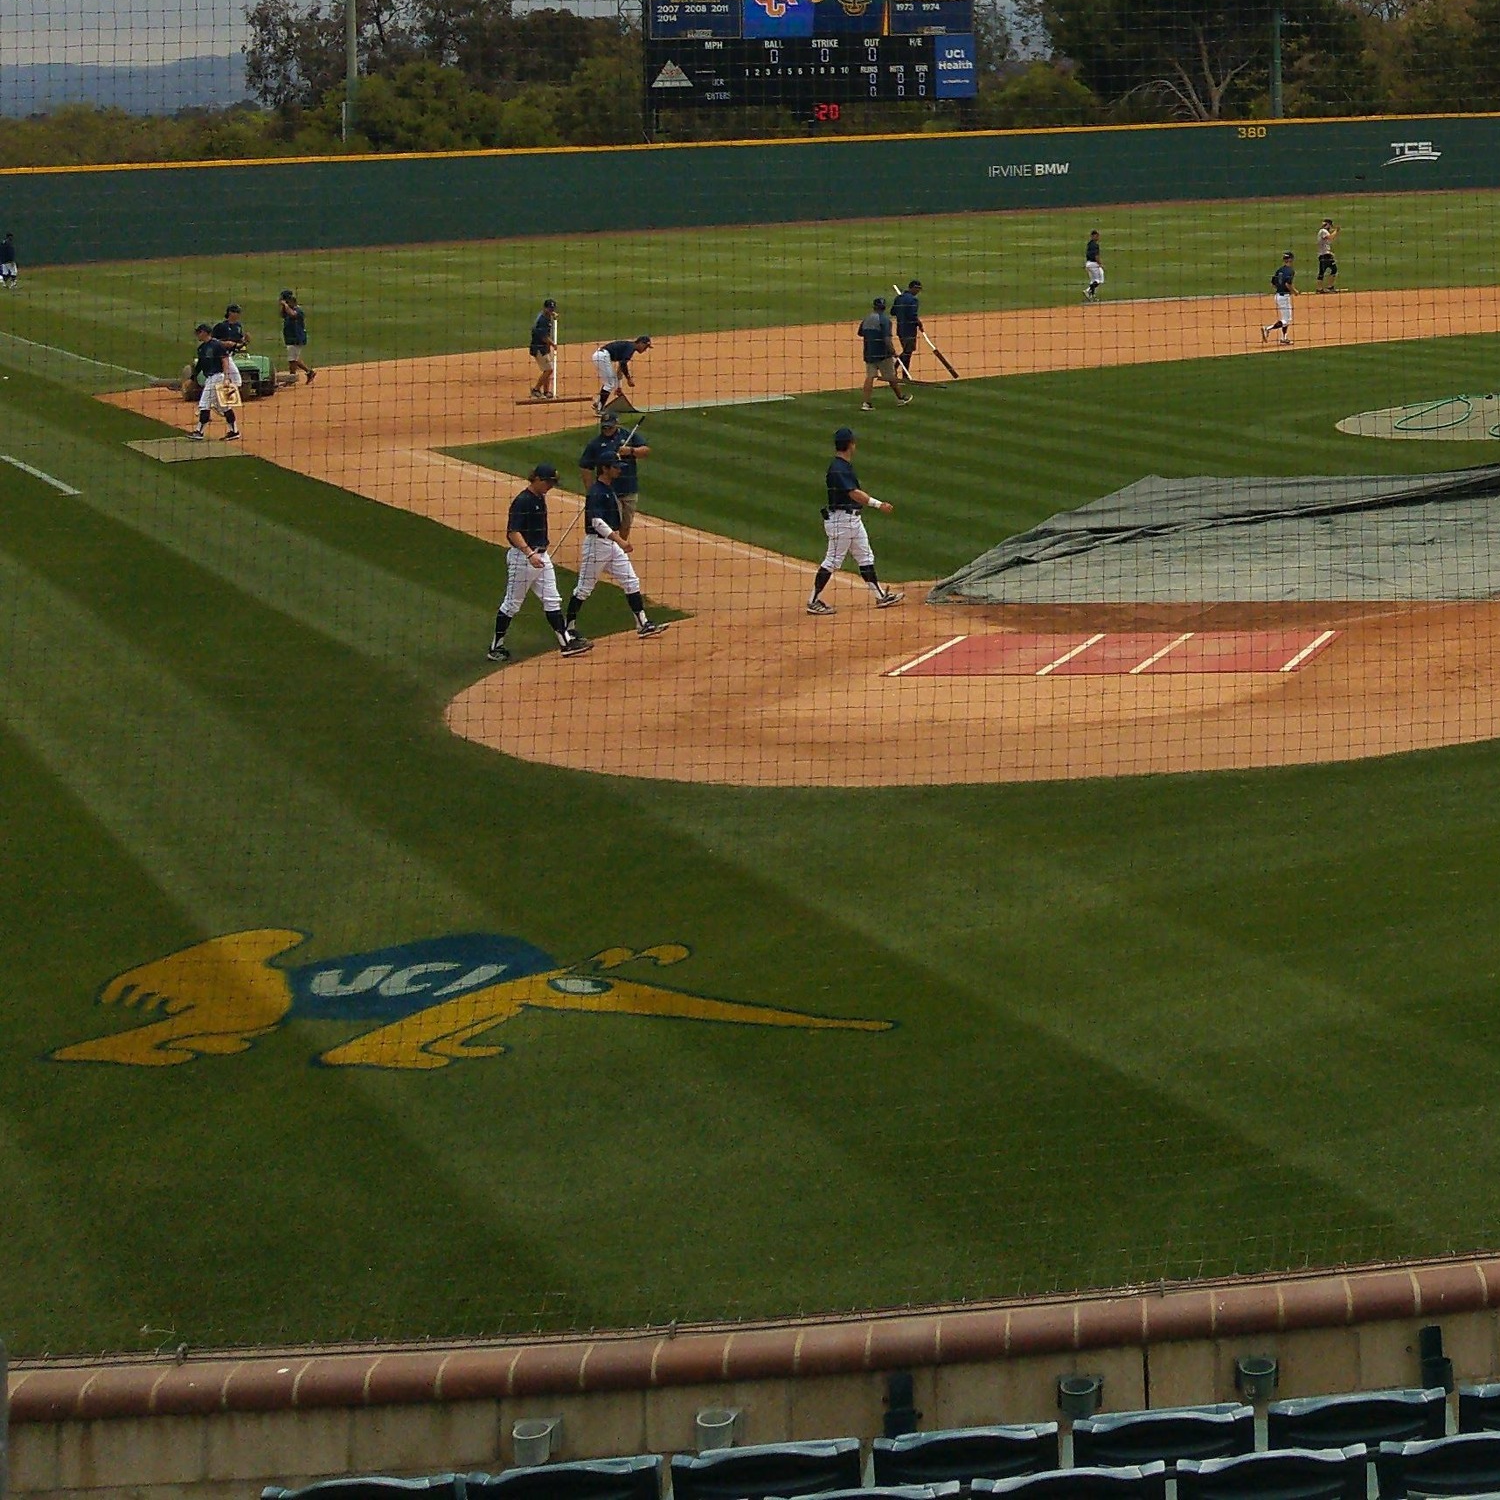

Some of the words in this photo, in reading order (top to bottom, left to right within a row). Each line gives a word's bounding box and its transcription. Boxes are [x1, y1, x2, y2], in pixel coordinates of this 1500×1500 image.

[657, 5, 679, 13] 2007
[896, 3, 914, 11] 1973
[922, 3, 940, 11] 1974
[704, 41, 723, 49] MPH
[764, 40, 784, 48] BALL
[812, 39, 838, 48] STRIKE
[864, 39, 880, 47] OUT
[770, 49, 778, 64] 0
[820, 48, 829, 62] 0
[868, 47, 877, 61] 0
[945, 49, 965, 58] UCI
[841, 66, 849, 74] 10
[938, 60, 973, 70] Health
[870, 73, 876, 84] 0
[897, 73, 904, 84] 0
[919, 72, 926, 83] 0
[897, 85, 904, 96] 0
[919, 85, 926, 96] 0
[1238, 127, 1267, 138] 380
[1391, 142, 1432, 155] TCS
[989, 164, 1032, 177] IRVINE
[1035, 162, 1069, 176] BMW
[311, 962, 508, 997] UCI
